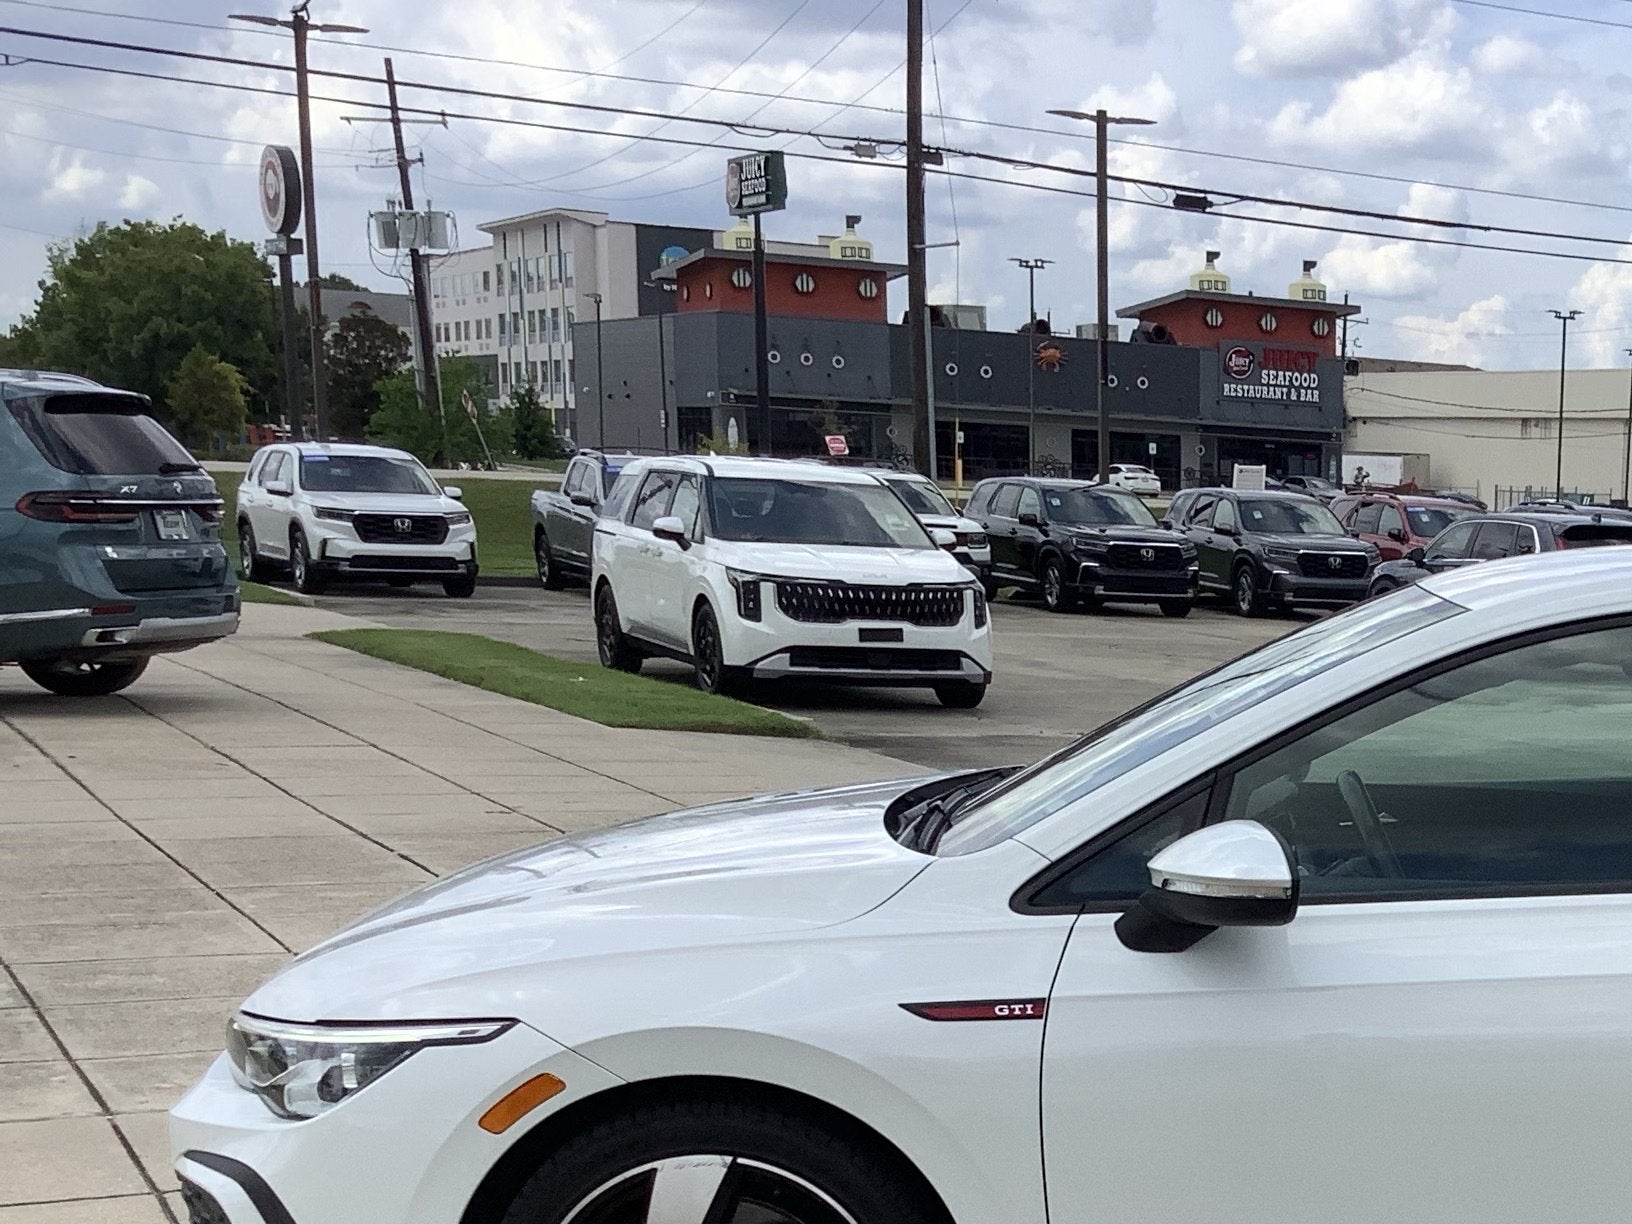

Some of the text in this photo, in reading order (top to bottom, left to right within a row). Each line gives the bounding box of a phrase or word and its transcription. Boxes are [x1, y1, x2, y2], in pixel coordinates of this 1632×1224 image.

[741, 155, 766, 180] JUICY
[1258, 348, 1318, 371] JUICY
[1261, 369, 1319, 388] SEAFOOD
[1223, 383, 1320, 402] RESTAURANT & BAR
[120, 485, 138, 493] X7
[994, 1004, 1034, 1015] GTI
